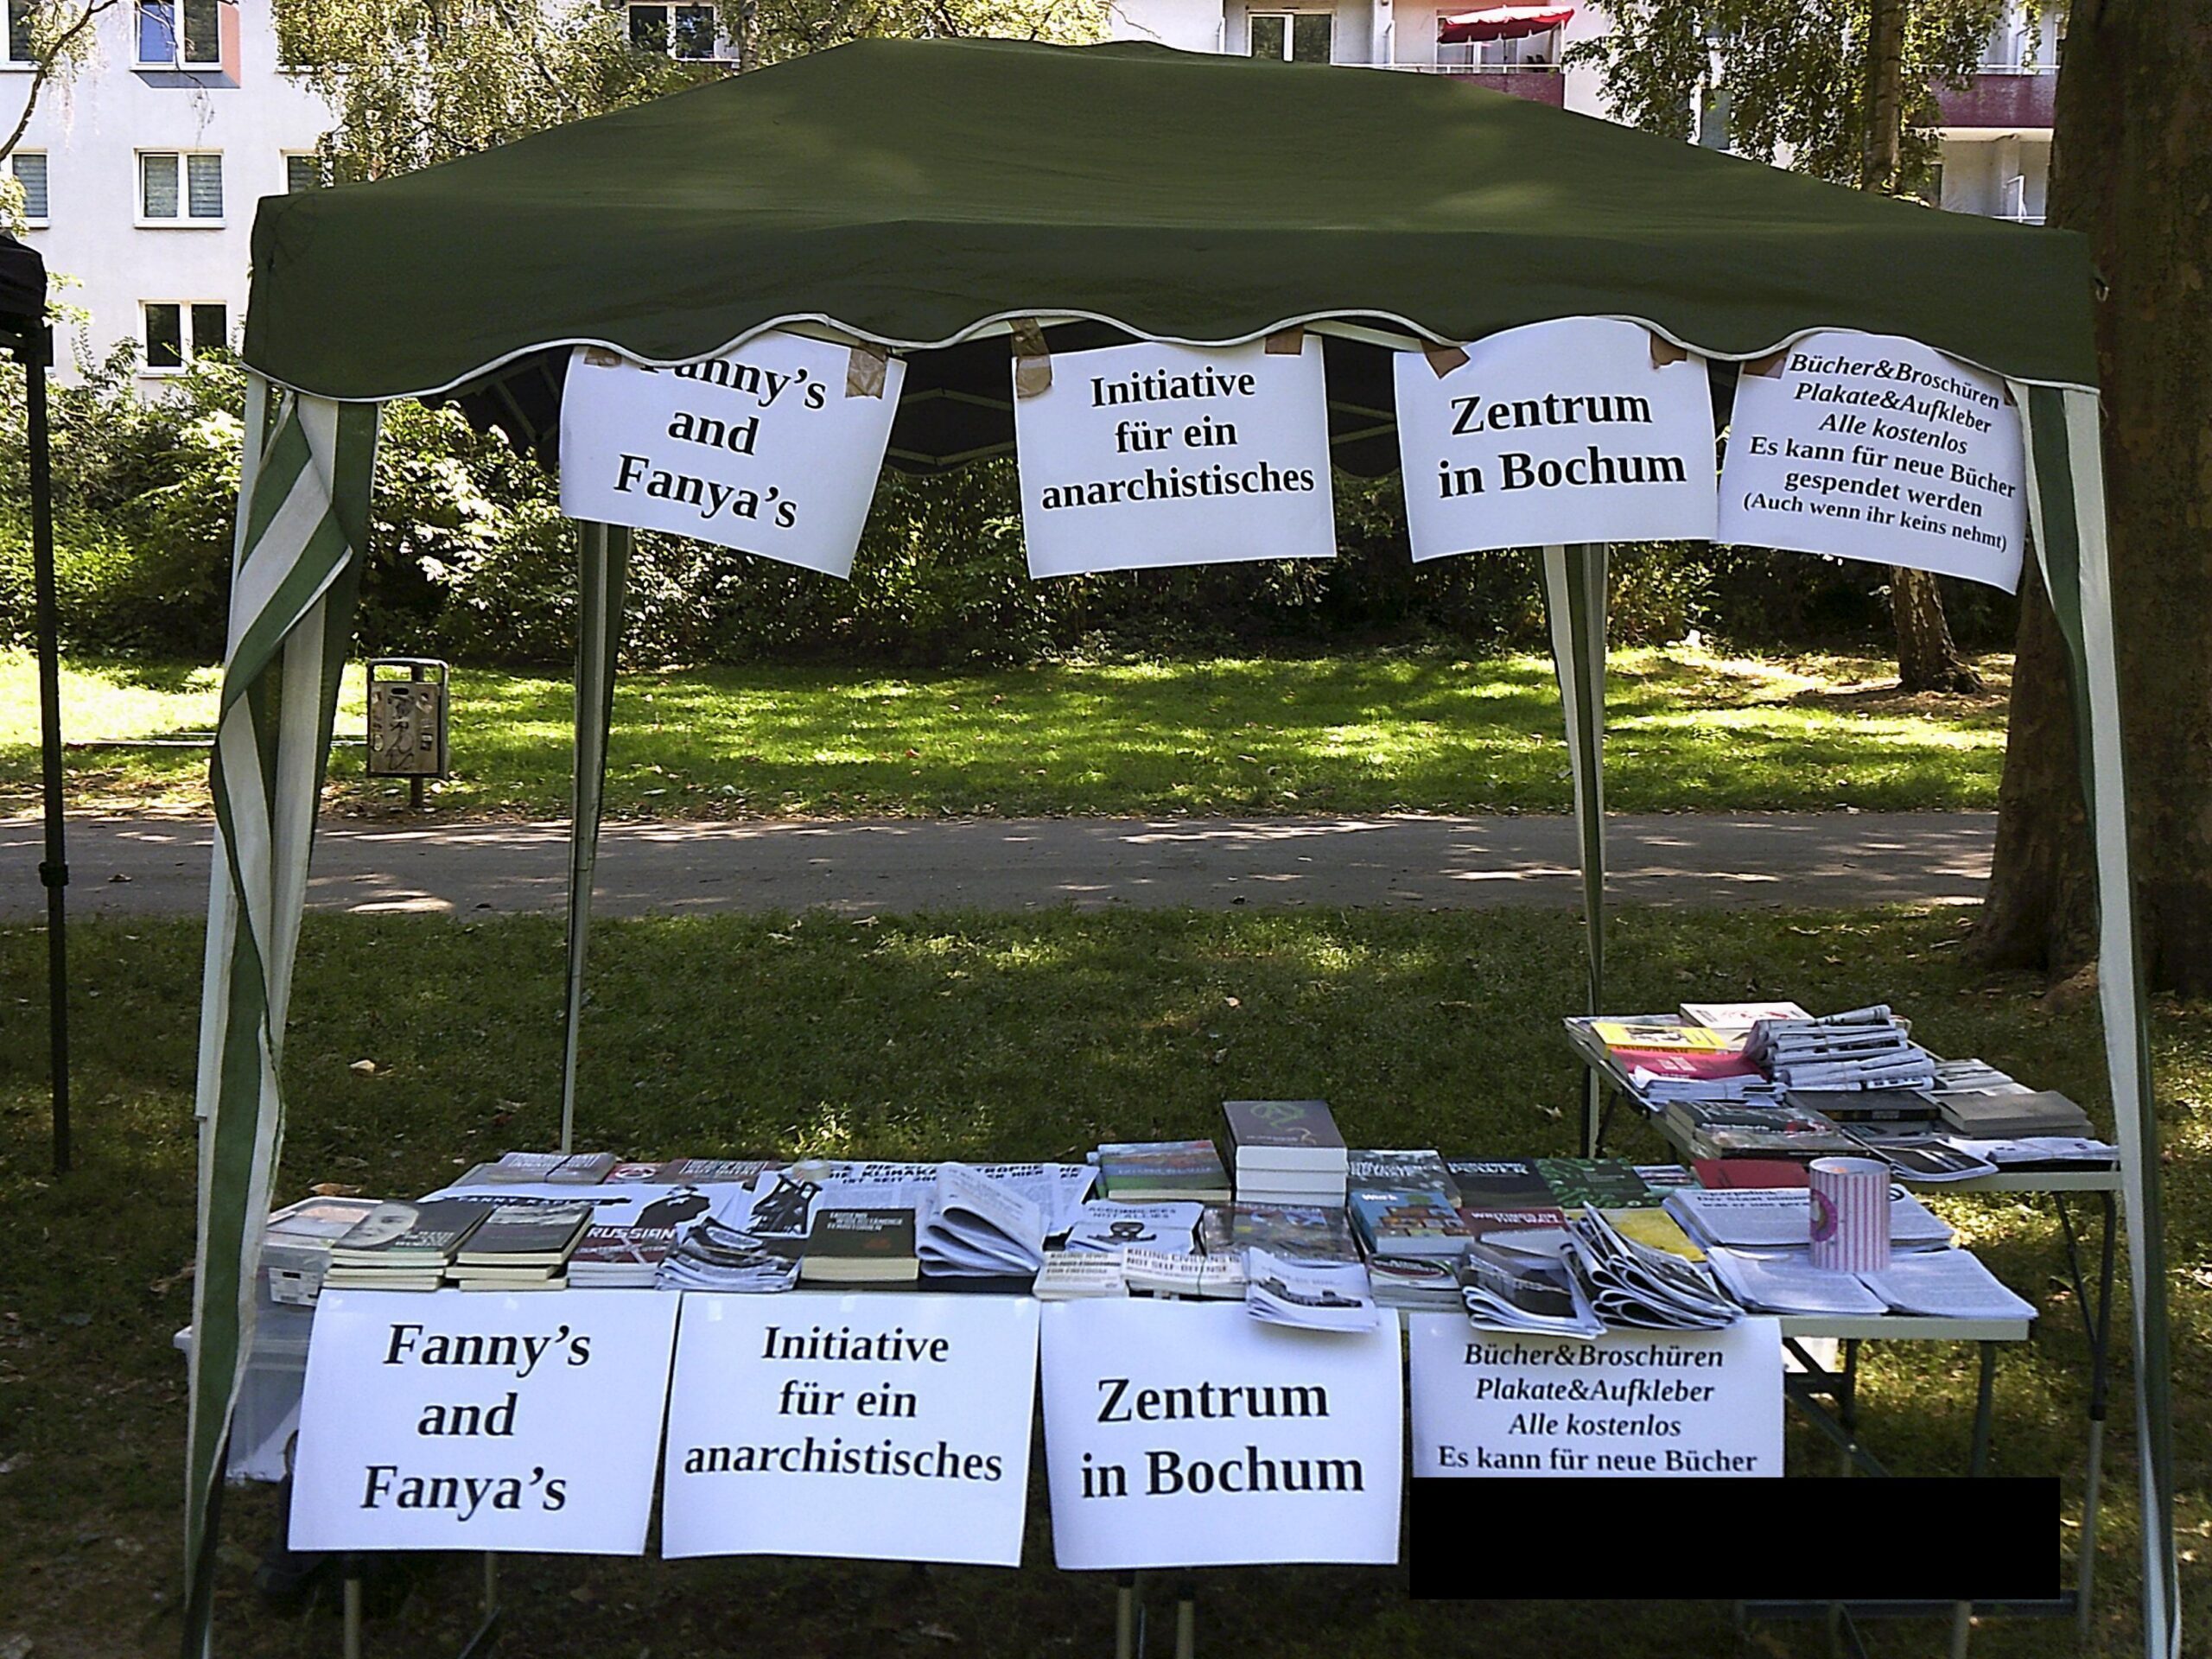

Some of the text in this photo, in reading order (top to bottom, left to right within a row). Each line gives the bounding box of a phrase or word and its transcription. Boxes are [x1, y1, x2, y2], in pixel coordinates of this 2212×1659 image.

[640, 359, 826, 409] anny’s
[1090, 365, 1255, 407] Initiative
[1789, 353, 2000, 410] Bücher&Broschüren
[1451, 392, 1652, 435] Zentrum
[1794, 382, 1993, 434] Plakate&Aufkleber
[668, 410, 760, 455] and
[1115, 416, 1237, 453] für ein
[1819, 414, 1967, 454] Alle kostenlos
[1041, 461, 1315, 509] anarchistisches
[1439, 446, 1687, 498] in Bochum
[1750, 436, 2015, 498] Es kann für neue Bücher
[613, 454, 798, 528] Fanya’s
[1784, 472, 1982, 517] gespendet werden
[1743, 493, 2007, 552] (Auch wenn ihr keins nehmt)
[587, 1226, 676, 1240] RUSSIAN
[1171, 1253, 1226, 1262] CIVILNS
[383, 1325, 591, 1378] Fanny’s
[761, 1326, 950, 1362] Initiative
[1464, 1344, 1723, 1367] Bücher&Broschüren
[417, 1392, 518, 1437] and
[779, 1380, 917, 1418] für ein
[1097, 1378, 1329, 1422] Zentrum
[1475, 1378, 1714, 1407] Plakate&Aufkleber
[1508, 1414, 1681, 1436] Alle kostenlos
[684, 1437, 1002, 1481] anarchistisches
[1081, 1446, 1364, 1497] in Bochum
[1438, 1446, 1758, 1473] Es kann für neue Bücher
[359, 1465, 566, 1522] Fanya’s
